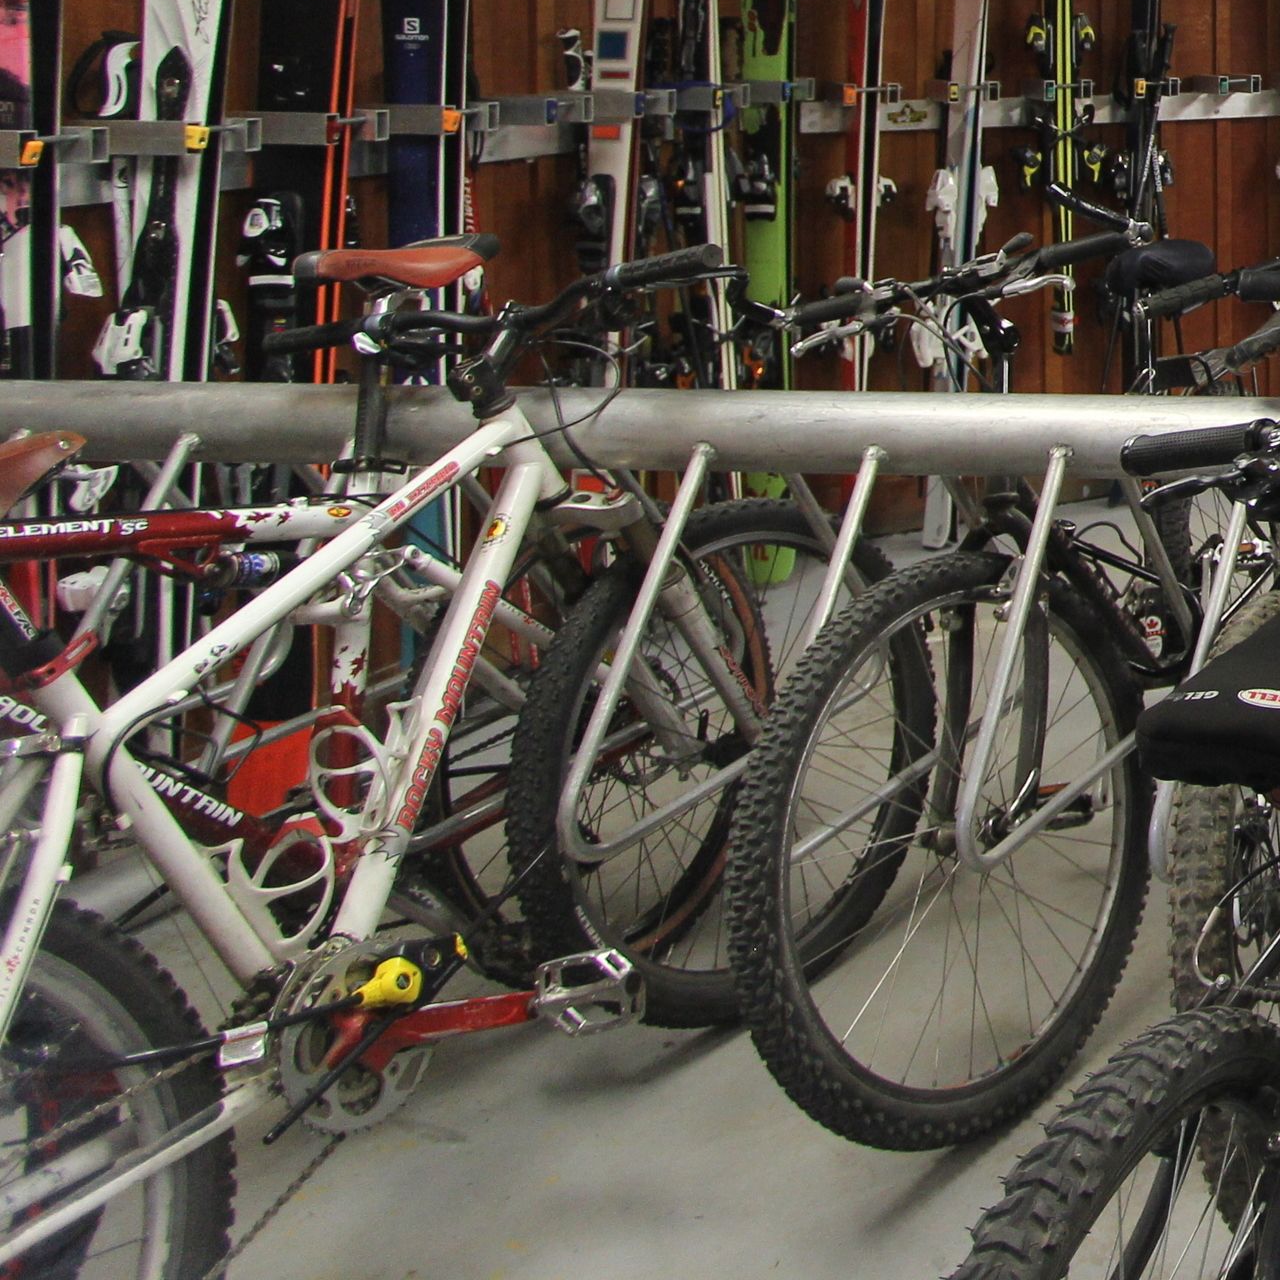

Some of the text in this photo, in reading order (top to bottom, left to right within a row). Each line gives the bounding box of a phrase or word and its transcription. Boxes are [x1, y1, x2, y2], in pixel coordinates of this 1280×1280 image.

[120, 521, 149, 536] SC
[434, 578, 502, 727] MOUNTAIN
[395, 726, 446, 832] ROCKY
